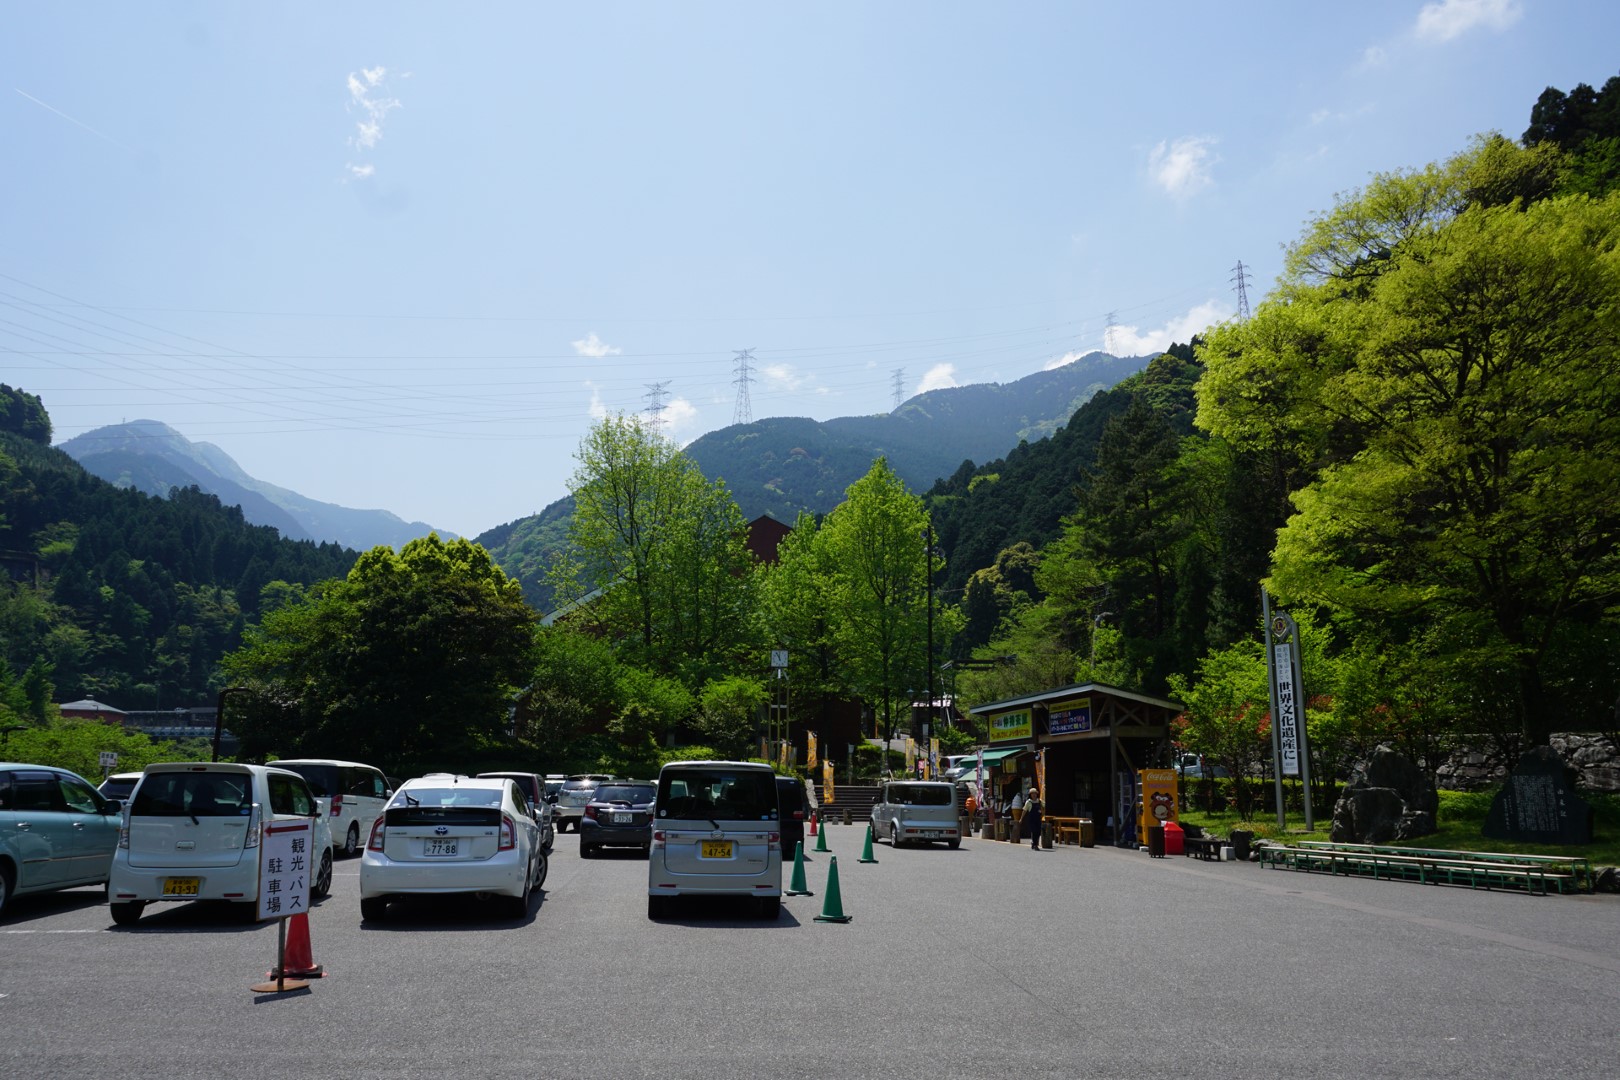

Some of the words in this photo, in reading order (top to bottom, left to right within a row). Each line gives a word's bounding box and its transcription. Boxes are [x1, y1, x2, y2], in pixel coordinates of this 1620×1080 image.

[1279, 681, 1296, 760] 世界文化遺産に
[431, 844, 456, 854] 77-88
[708, 848, 731, 857] 47-54
[171, 885, 197, 894] 43-93
[266, 857, 283, 914] 駐車場
[289, 838, 305, 909] 観光バス
